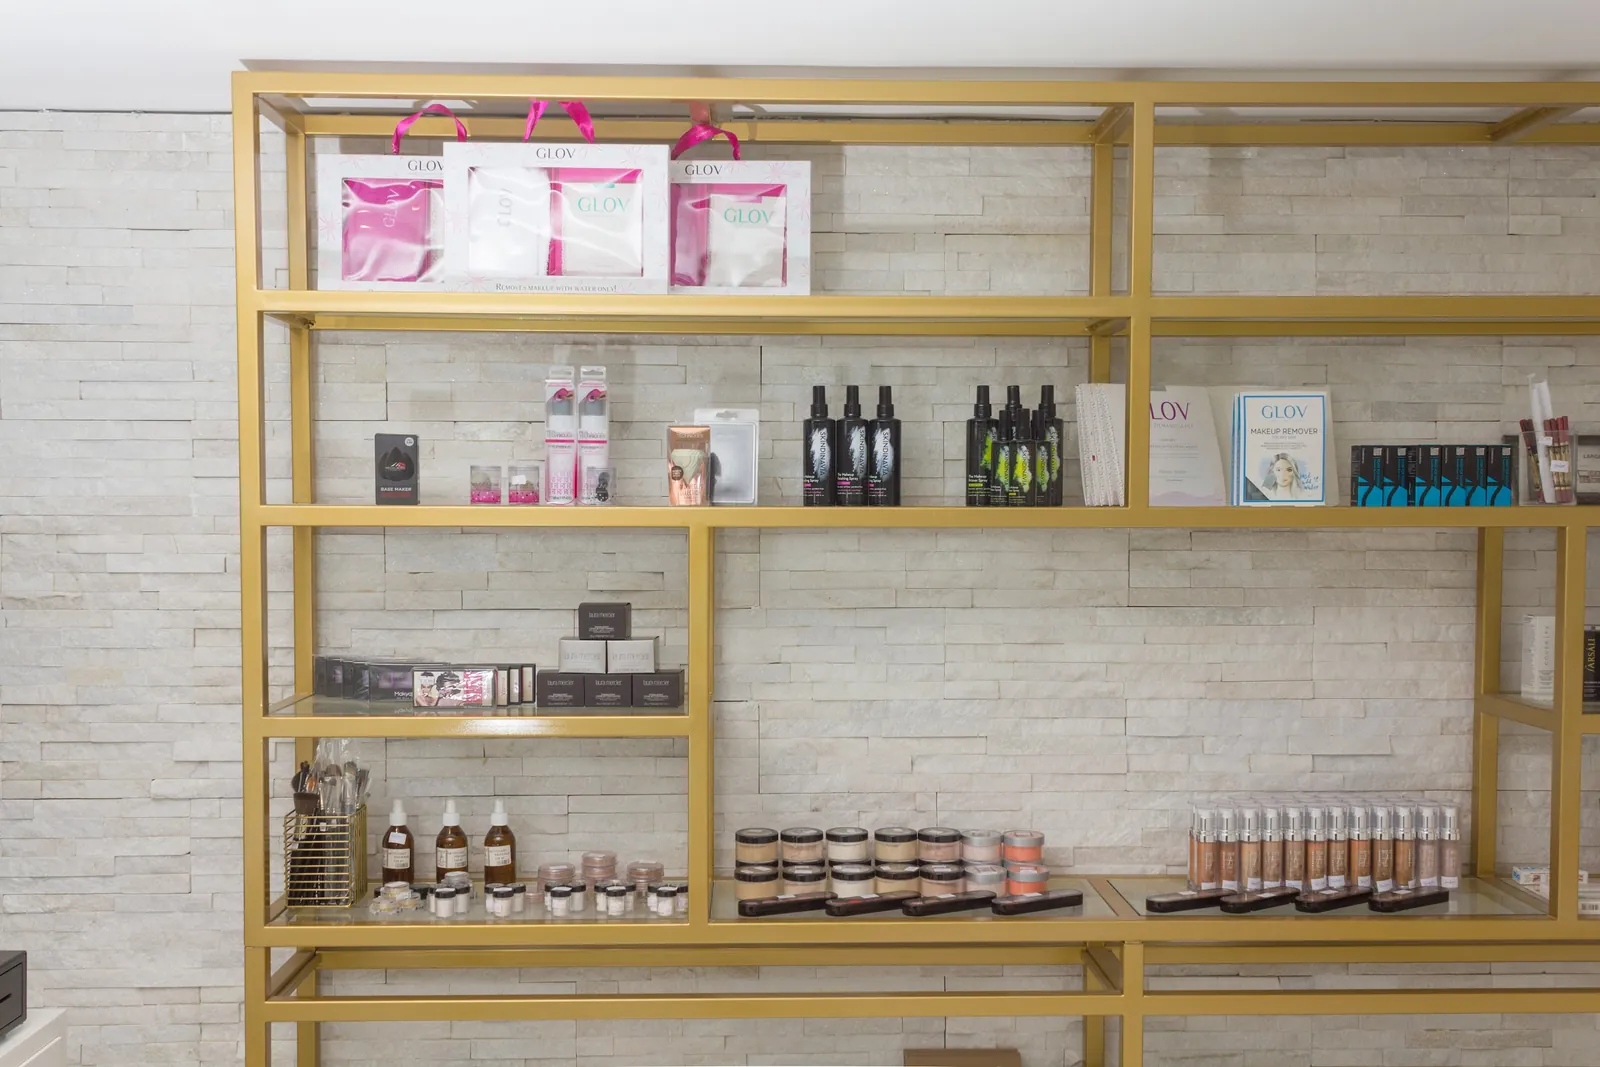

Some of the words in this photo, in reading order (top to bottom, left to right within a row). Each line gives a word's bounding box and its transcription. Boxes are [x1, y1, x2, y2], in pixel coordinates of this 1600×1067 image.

[536, 147, 576, 160] GLOV
[408, 160, 444, 172] GLOV
[685, 164, 723, 176] GLOV
[577, 197, 631, 213] GLOV
[724, 208, 773, 224] GLOV
[1150, 402, 1190, 421] LOV
[1261, 404, 1308, 420] GLOV
[1250, 427, 1282, 435] MAKEUP
[1283, 427, 1318, 435] REMOVER
